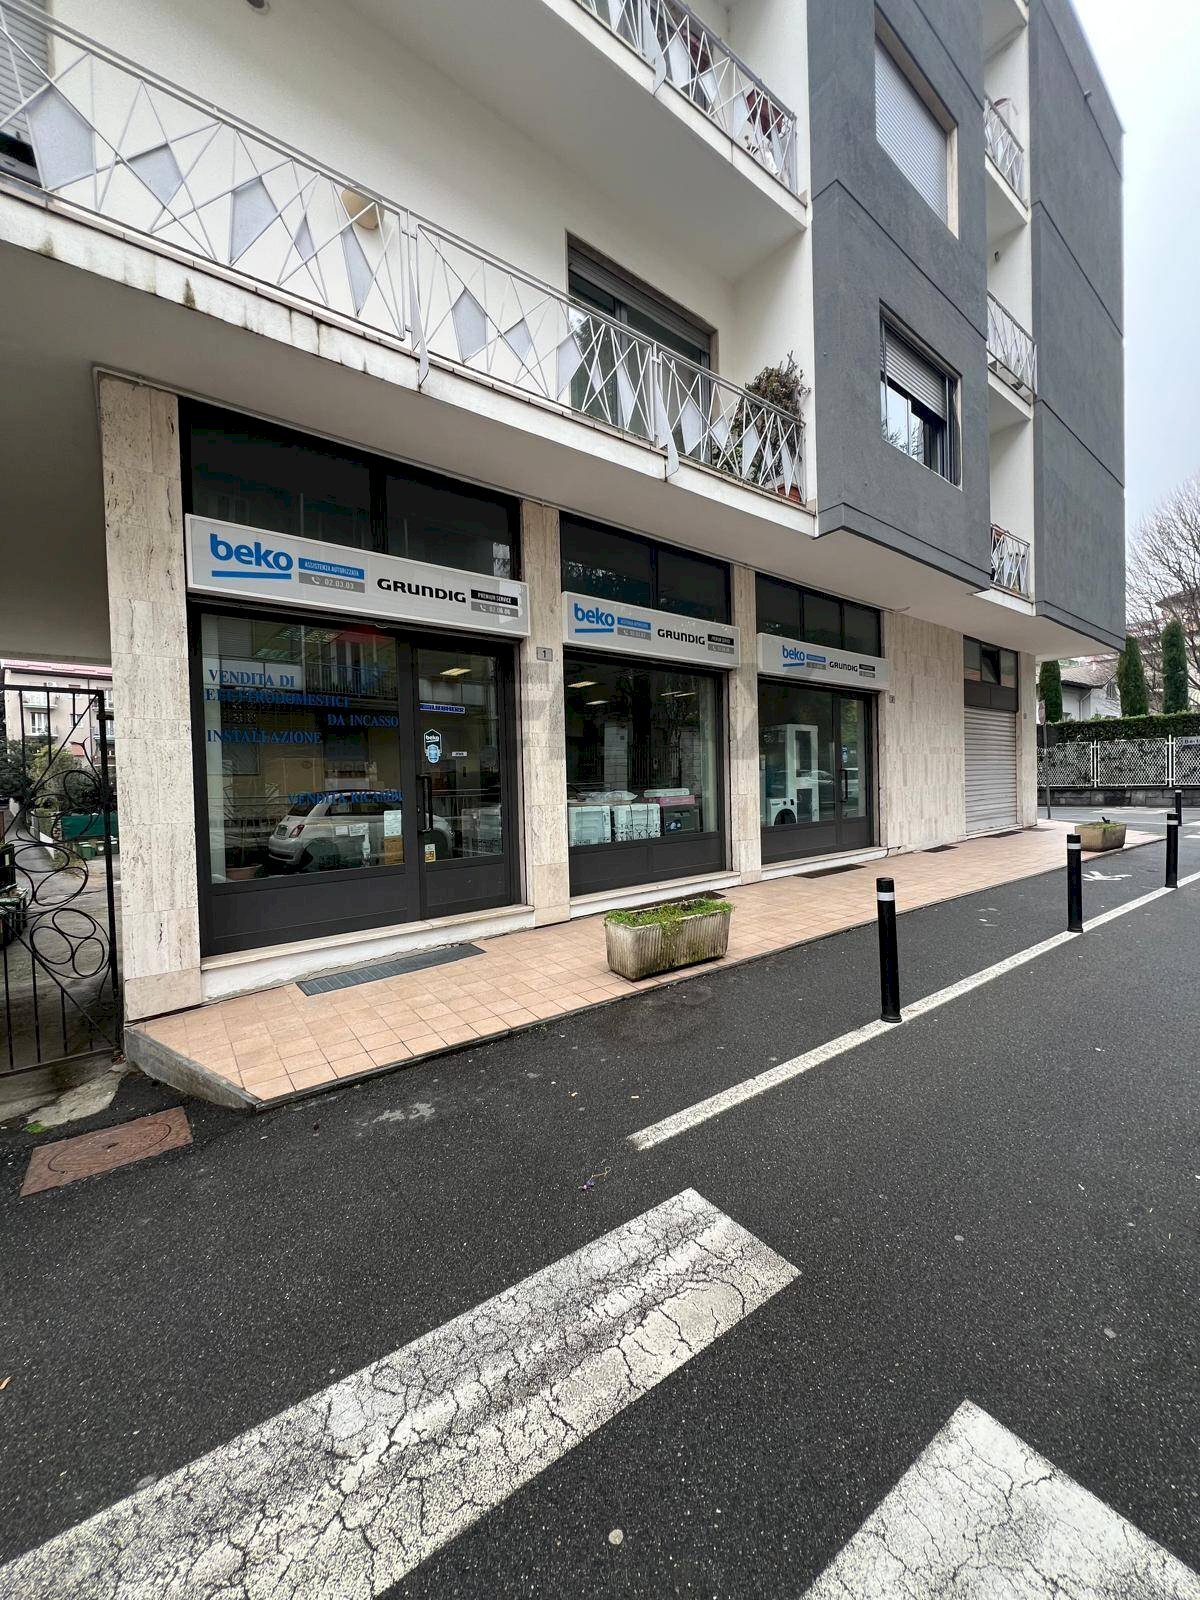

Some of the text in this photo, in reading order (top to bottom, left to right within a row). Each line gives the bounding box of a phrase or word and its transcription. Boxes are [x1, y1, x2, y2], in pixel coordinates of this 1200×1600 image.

[210, 533, 293, 571] beko
[377, 578, 466, 603] GRUNDIG
[574, 603, 615, 627] beko
[657, 629, 705, 646] GRUNDIG
[542, 649, 546, 658] 1
[782, 645, 805, 662] beko
[829, 661, 858, 673] GRUNDIG
[208, 669, 295, 688] VENDITA DI
[327, 713, 399, 727] DA INCASSO
[206, 728, 322, 745] INSTALLAZIONE
